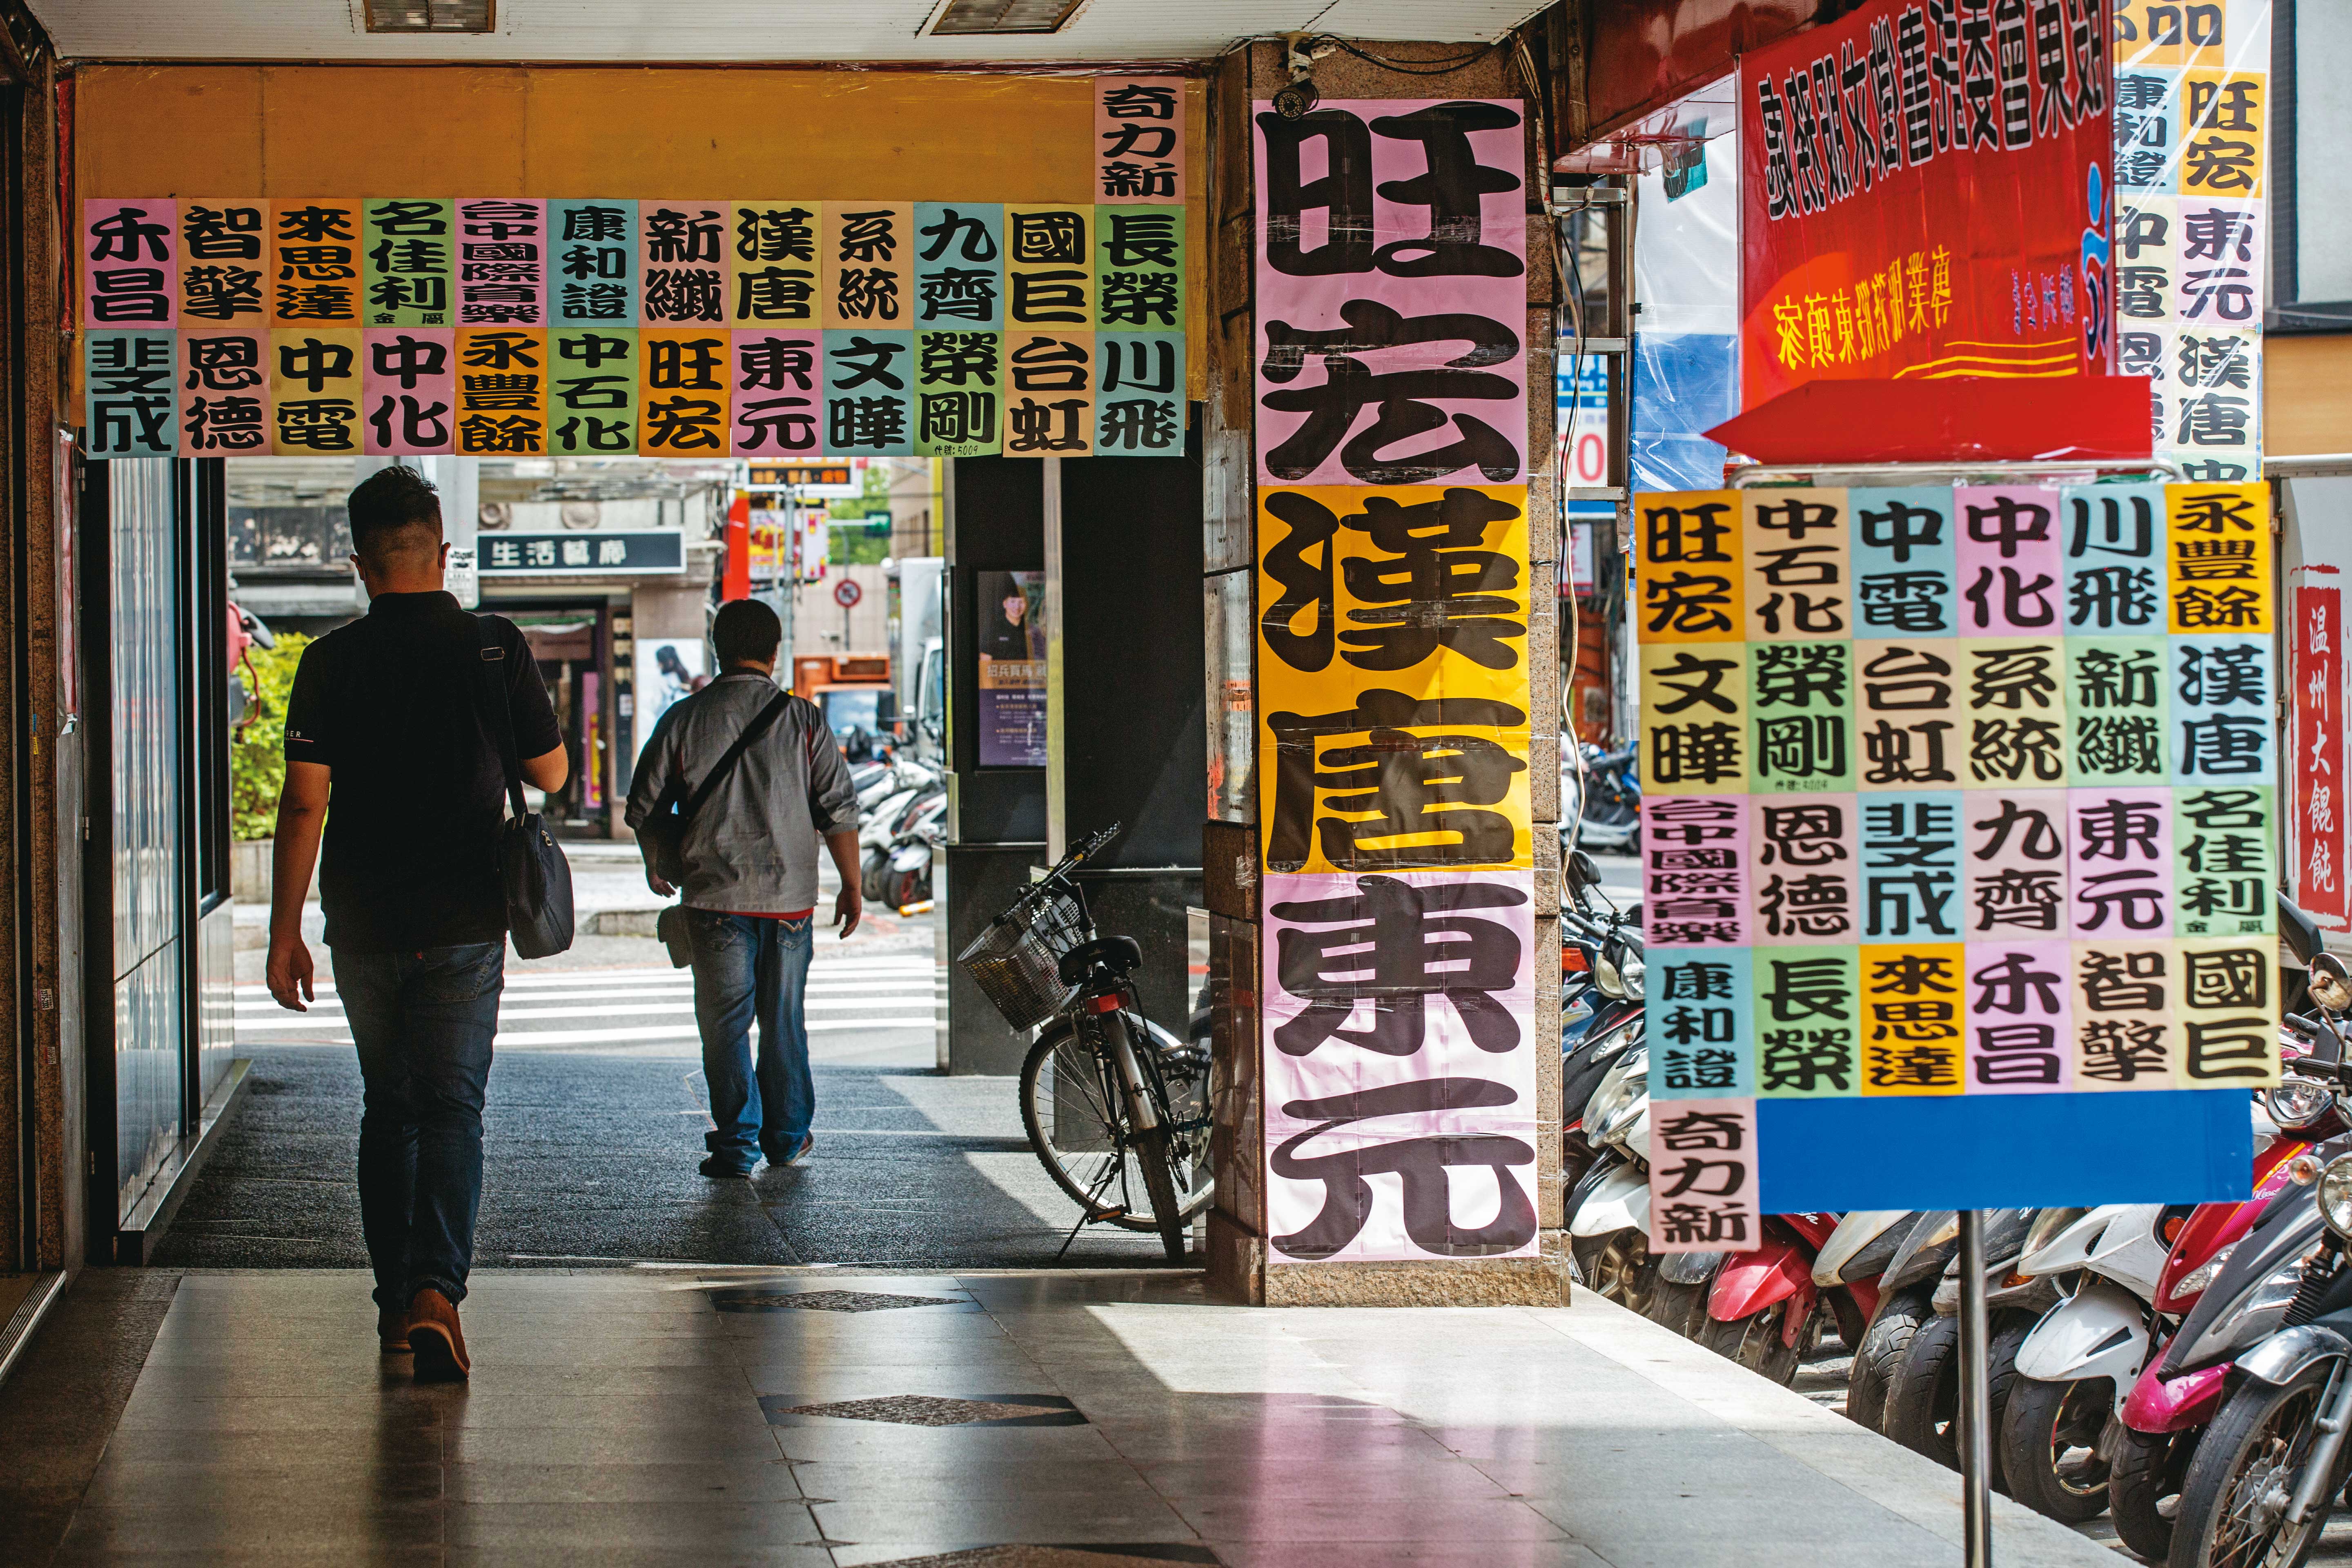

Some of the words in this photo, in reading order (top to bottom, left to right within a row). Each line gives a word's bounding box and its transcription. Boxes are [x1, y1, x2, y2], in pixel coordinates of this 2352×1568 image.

[1100, 85, 1178, 197] 奇力新
[2187, 80, 2258, 190] 旺宏
[91, 208, 170, 321] 禾昌
[183, 206, 263, 320] 智擎
[276, 206, 356, 319] 來思達
[369, 202, 448, 310] 名佳利
[461, 201, 540, 323] 台中國際育樂
[561, 206, 628, 318] 康和證
[645, 209, 724, 322] 新纖
[737, 208, 815, 319] 漢唐
[838, 210, 898, 320] 系統
[920, 209, 997, 321] 九齊
[1011, 212, 1088, 323] 國巨
[1101, 214, 1178, 325] 長榮
[1254, 100, 1525, 485] 旺宏
[2180, 207, 2256, 320] 東元
[373, 313, 443, 324] 金屬
[91, 338, 171, 452] 斐成
[185, 336, 264, 450] 恩德
[277, 338, 356, 450] 中電
[370, 335, 448, 448] 中化
[459, 332, 541, 452] 永豐餘
[556, 334, 630, 450] 中石化
[647, 339, 723, 449] 旺宏
[737, 337, 816, 450] 東元
[829, 336, 906, 449] 文曄
[920, 332, 999, 443] 榮剛
[1009, 337, 1089, 451] 台虹
[1100, 341, 1177, 449] 川飛
[2117, 332, 2165, 441] 恩
[2177, 335, 2251, 445] 漢唐
[934, 444, 978, 456] 代號:5009
[1644, 503, 1732, 633] 旺宏
[1755, 499, 1843, 634] 中石化
[1859, 501, 1949, 631] 中電
[1965, 497, 2054, 628] 中化
[2069, 497, 2157, 628] 川飛
[2174, 494, 2260, 627] 永豐餘
[1260, 486, 1529, 874] 漢唐
[1756, 645, 1846, 777] 榮剛
[1863, 647, 1956, 784] 台虹
[1970, 646, 2062, 781] 系統
[2076, 649, 2161, 774] 新纖
[2179, 644, 2266, 775] 漢唐
[1649, 800, 1740, 943] 台中國際育樂
[1759, 804, 1849, 936] 恩德
[1865, 803, 1956, 935] 斐成
[1973, 800, 2062, 931] 九齊
[2077, 800, 2163, 931] 東元
[2180, 791, 2266, 916] 名佳利
[1268, 873, 1538, 1262] 東元
[1662, 962, 1737, 1089] 康和證
[1762, 958, 1851, 1091] 長榮
[1870, 955, 1958, 1087] 來思達
[2080, 951, 2167, 1082] 智擎
[2183, 949, 2270, 1079] 國巨
[1659, 1111, 1748, 1243] 奇力新
